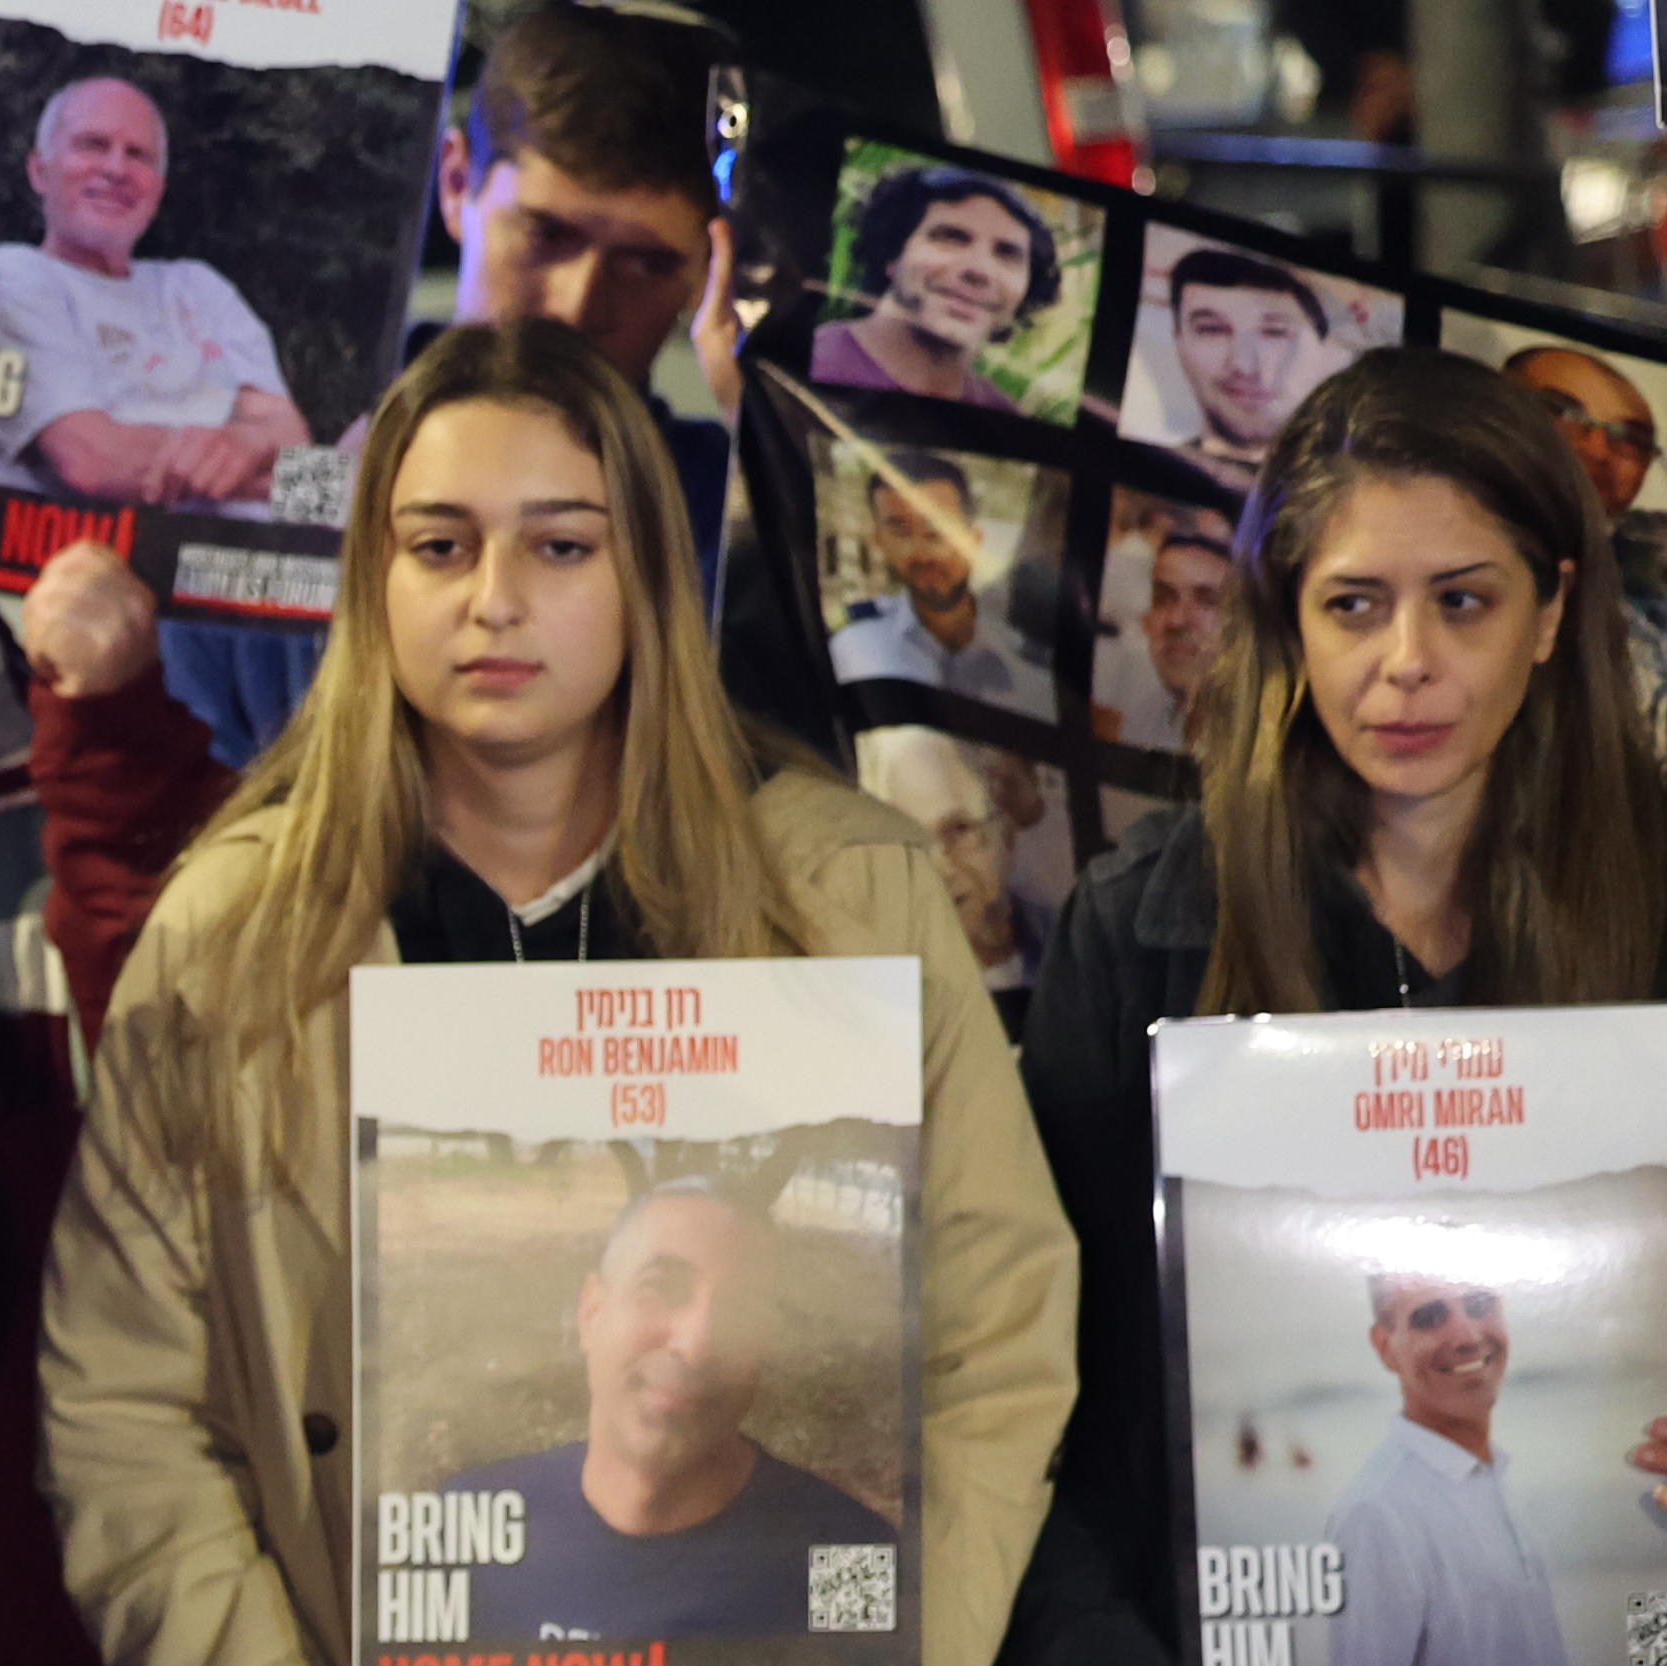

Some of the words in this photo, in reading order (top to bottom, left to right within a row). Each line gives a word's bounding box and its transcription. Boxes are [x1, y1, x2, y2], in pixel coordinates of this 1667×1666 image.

[575, 986, 654, 1032] בנימין
[665, 986, 701, 1031] רון
[538, 1037, 593, 1077] RON
[603, 1034, 739, 1076] BENJAMIN
[610, 1082, 667, 1127] (53)
[1355, 1091, 1425, 1132] OMRI
[1433, 1085, 1525, 1128] MIRAN
[1413, 1134, 1470, 1182] (46)
[378, 1490, 525, 1566] BRING
[1199, 1543, 1345, 1617] BRING
[378, 1568, 470, 1643] HIM
